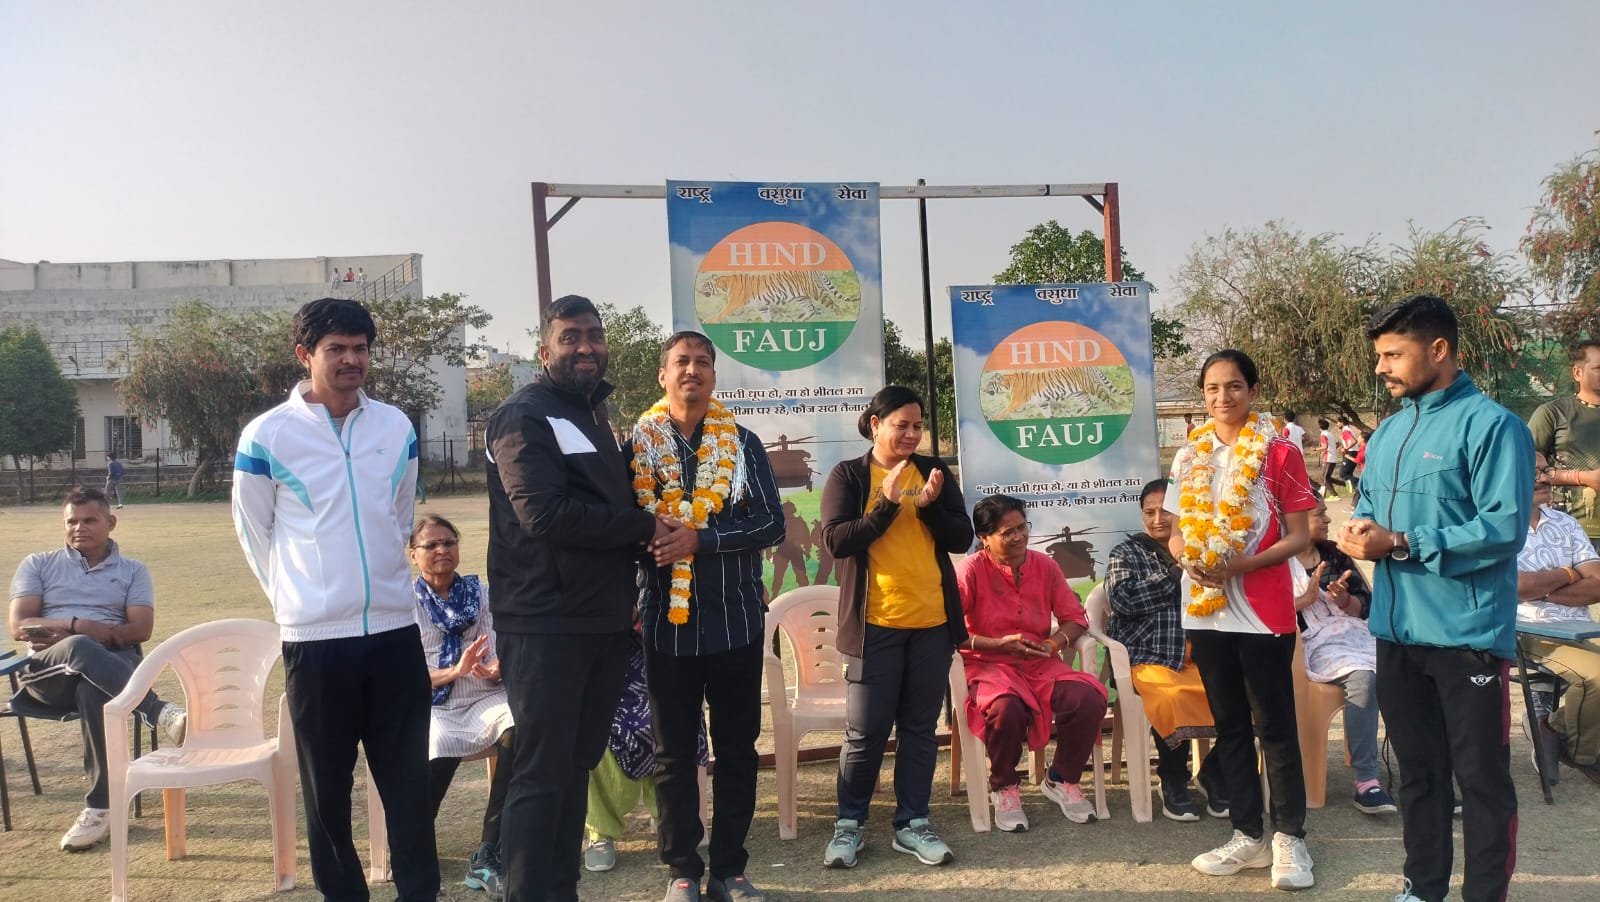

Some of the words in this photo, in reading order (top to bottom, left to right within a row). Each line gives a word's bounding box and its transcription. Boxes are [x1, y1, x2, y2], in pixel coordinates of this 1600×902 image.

[677, 186, 713, 203] राष्ट्र
[758, 187, 803, 204] वसुधा
[837, 185, 868, 200] सेवा
[727, 242, 827, 266] HIND
[961, 290, 994, 305] राष्ट्र
[1036, 287, 1078, 304] वसुधा
[1109, 284, 1138, 298] सेवा
[733, 329, 827, 353] FAUJ
[1008, 339, 1101, 365] HIND
[716, 388, 745, 400] तपती
[748, 389, 765, 401] धूप
[768, 388, 782, 399] हो,
[785, 389, 797, 398] या
[800, 387, 810, 397] हो
[813, 386, 843, 397] शीतल
[757, 406, 770, 415] पर
[818, 404, 837, 413] सदा
[1016, 422, 1104, 448] FAUJ
[1003, 482, 1029, 494] तपती
[1032, 482, 1048, 495] धूप
[1051, 481, 1064, 491] हो,
[1066, 481, 1078, 490] या
[1080, 479, 1090, 489] हो
[1093, 478, 1122, 488] शीतल
[1041, 499, 1054, 508] पर
[1098, 496, 1117, 504] सदा
